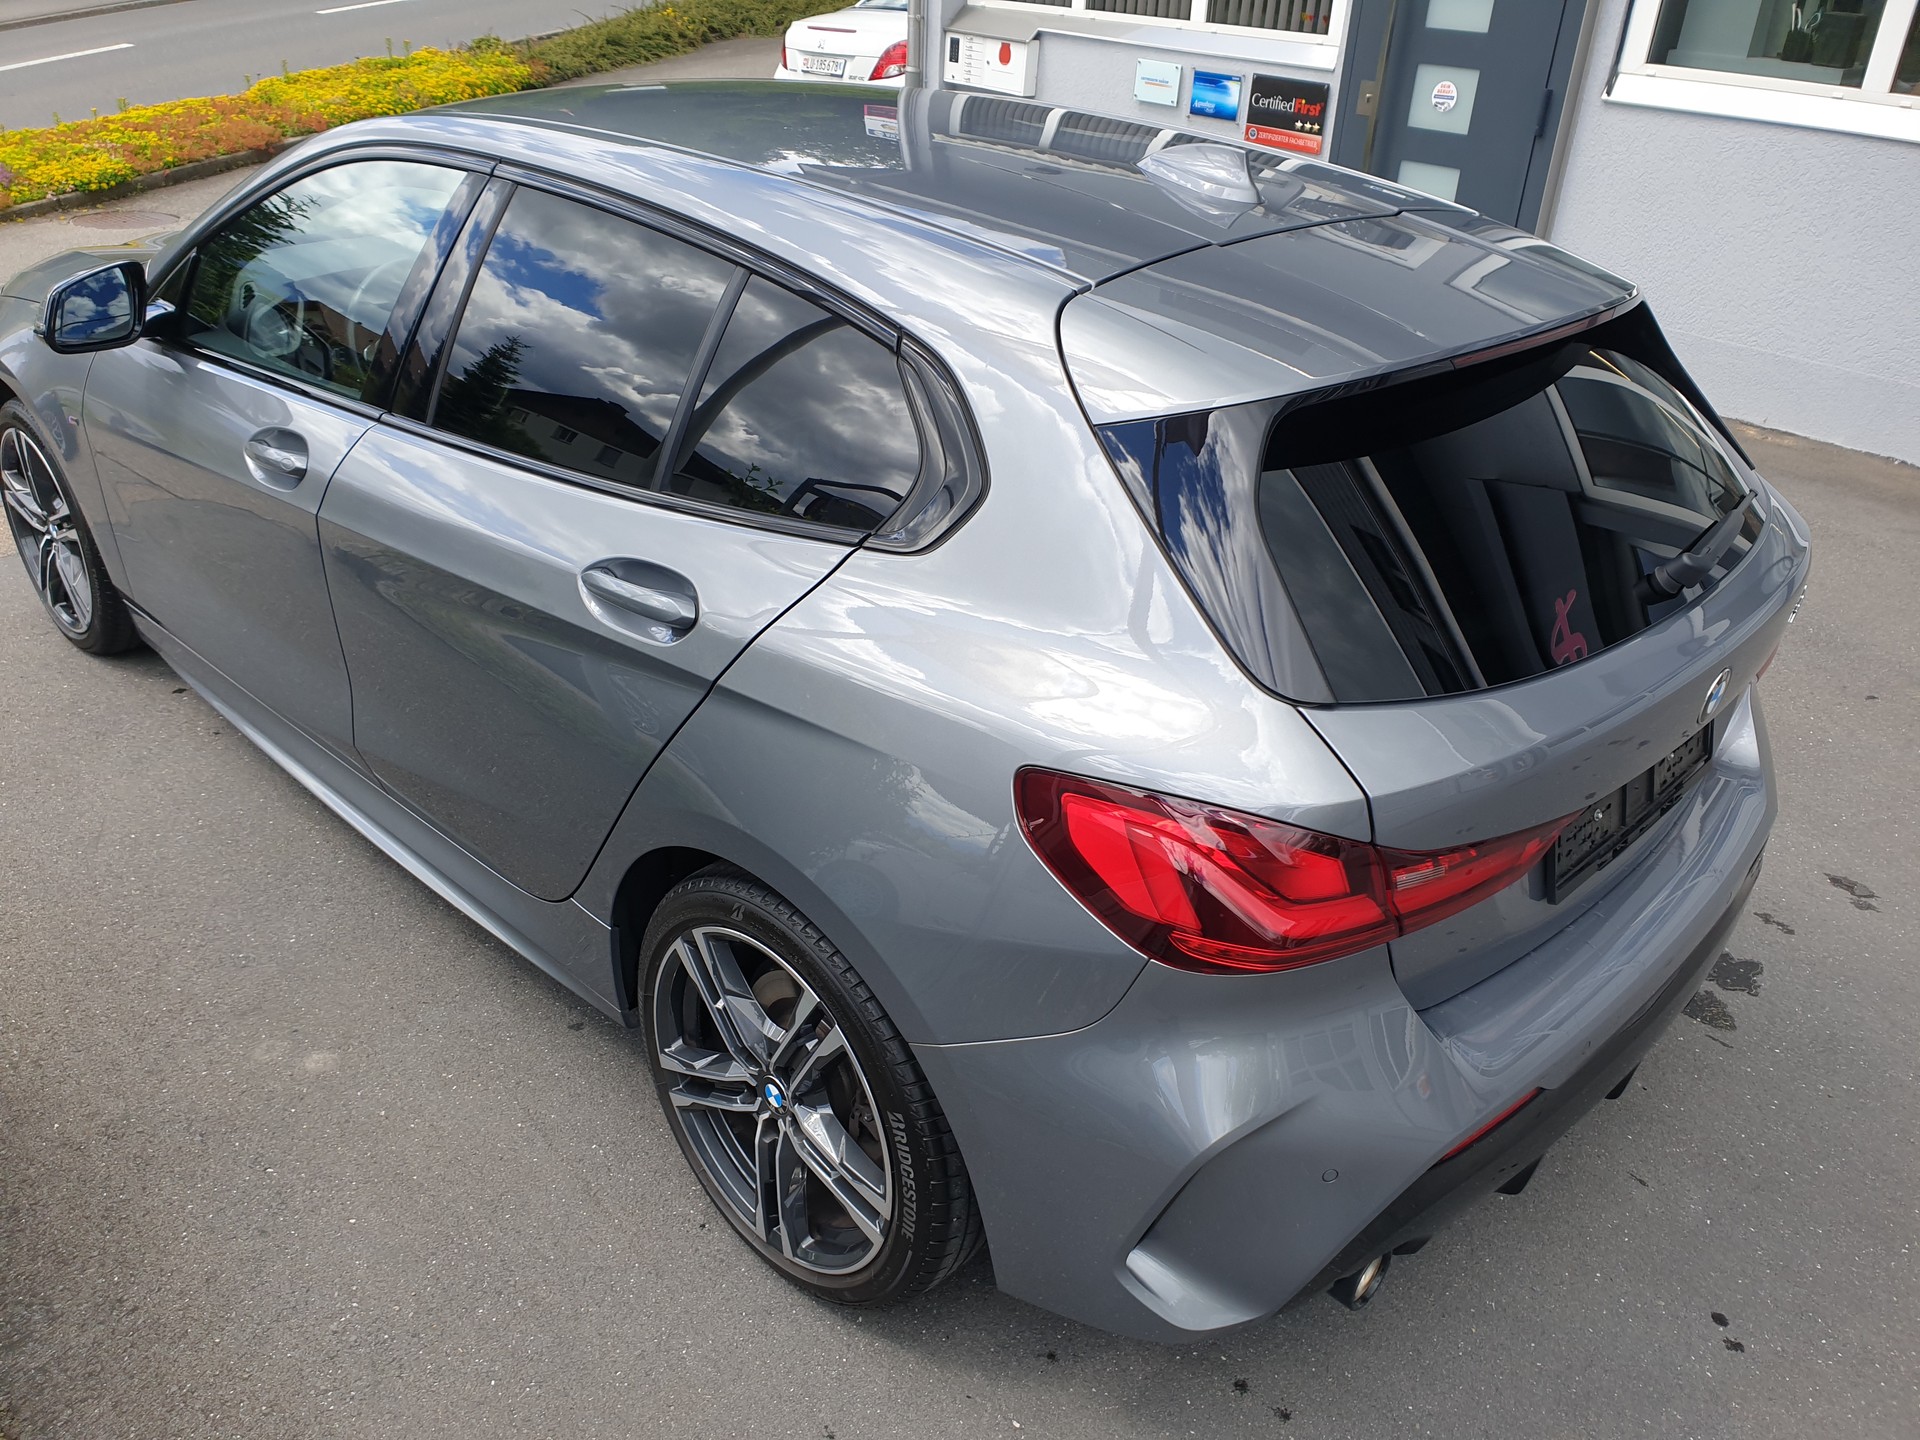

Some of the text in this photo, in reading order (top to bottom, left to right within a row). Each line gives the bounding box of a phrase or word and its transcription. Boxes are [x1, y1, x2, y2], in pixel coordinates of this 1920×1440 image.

[1251, 93, 1321, 117] CertifiedFirst
[1258, 131, 1318, 147] ZERTIFIZIERTER FACHBETRIEB
[887, 1110, 917, 1243] BRIDGESTONE
